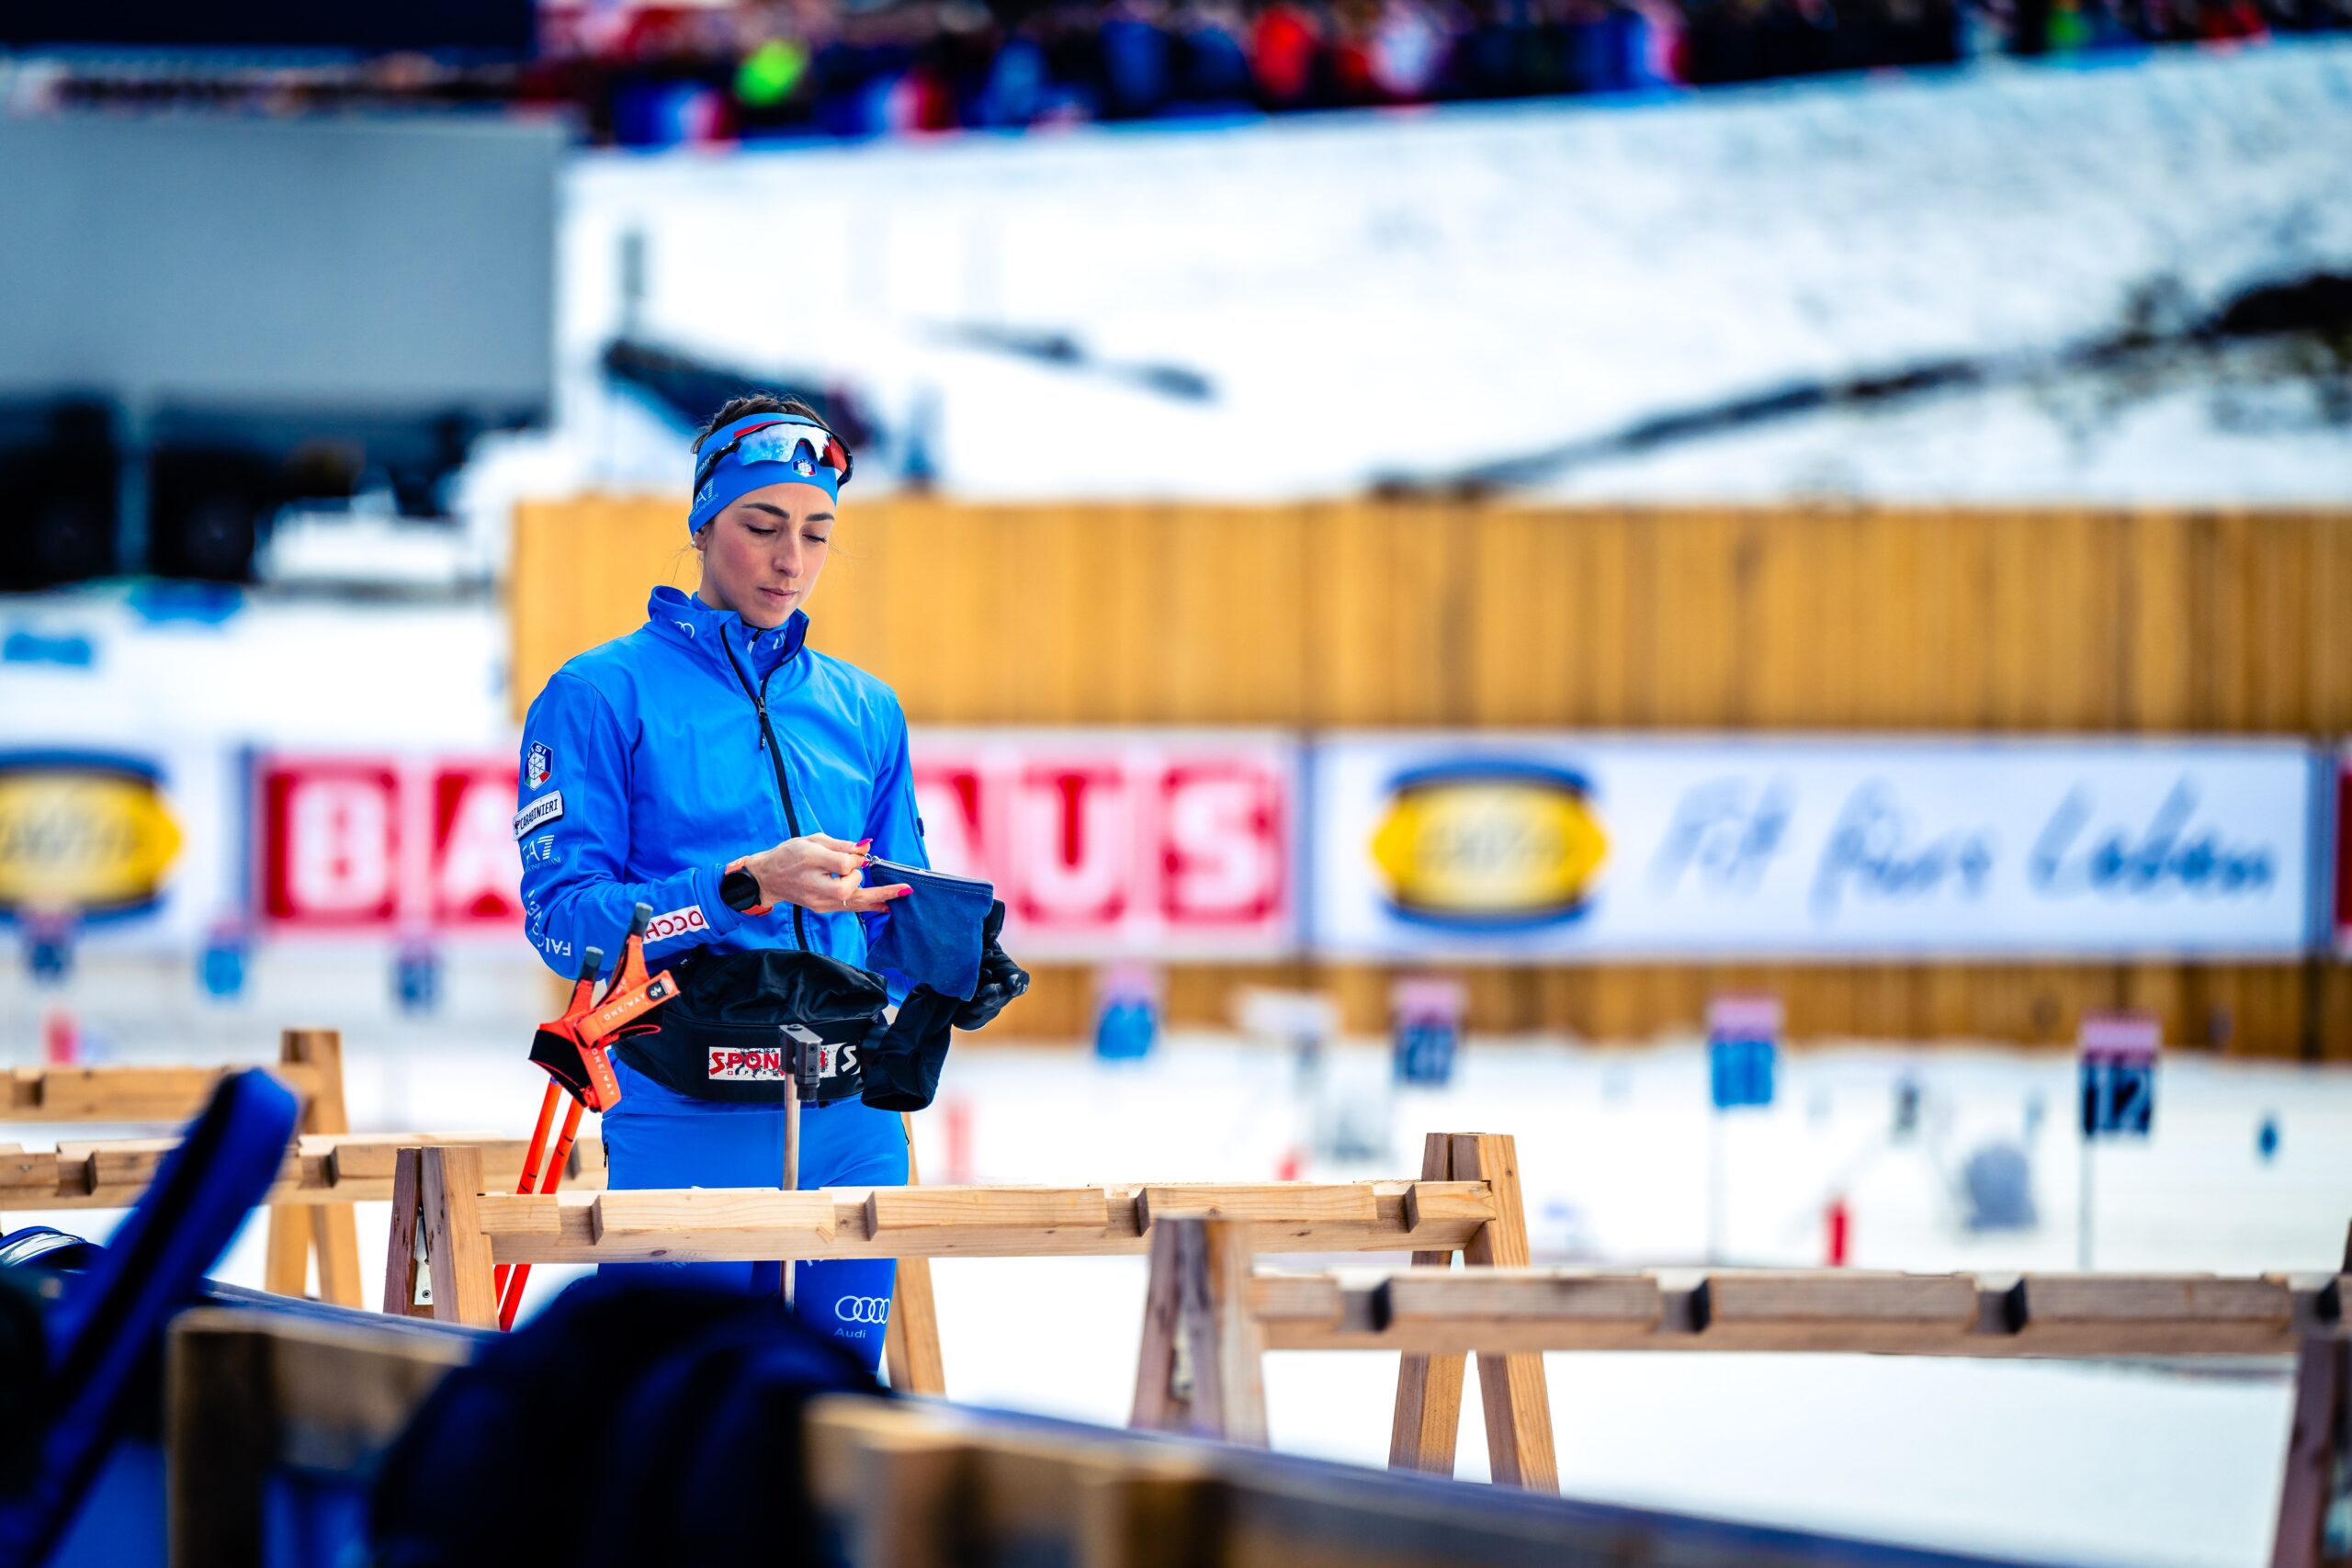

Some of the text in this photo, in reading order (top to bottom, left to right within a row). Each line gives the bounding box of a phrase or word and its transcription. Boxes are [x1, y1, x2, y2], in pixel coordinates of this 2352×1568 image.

[520, 798, 559, 830] CARABINIERI
[288, 779, 1272, 913] BAAUS
[833, 1327, 866, 1338] Audi
